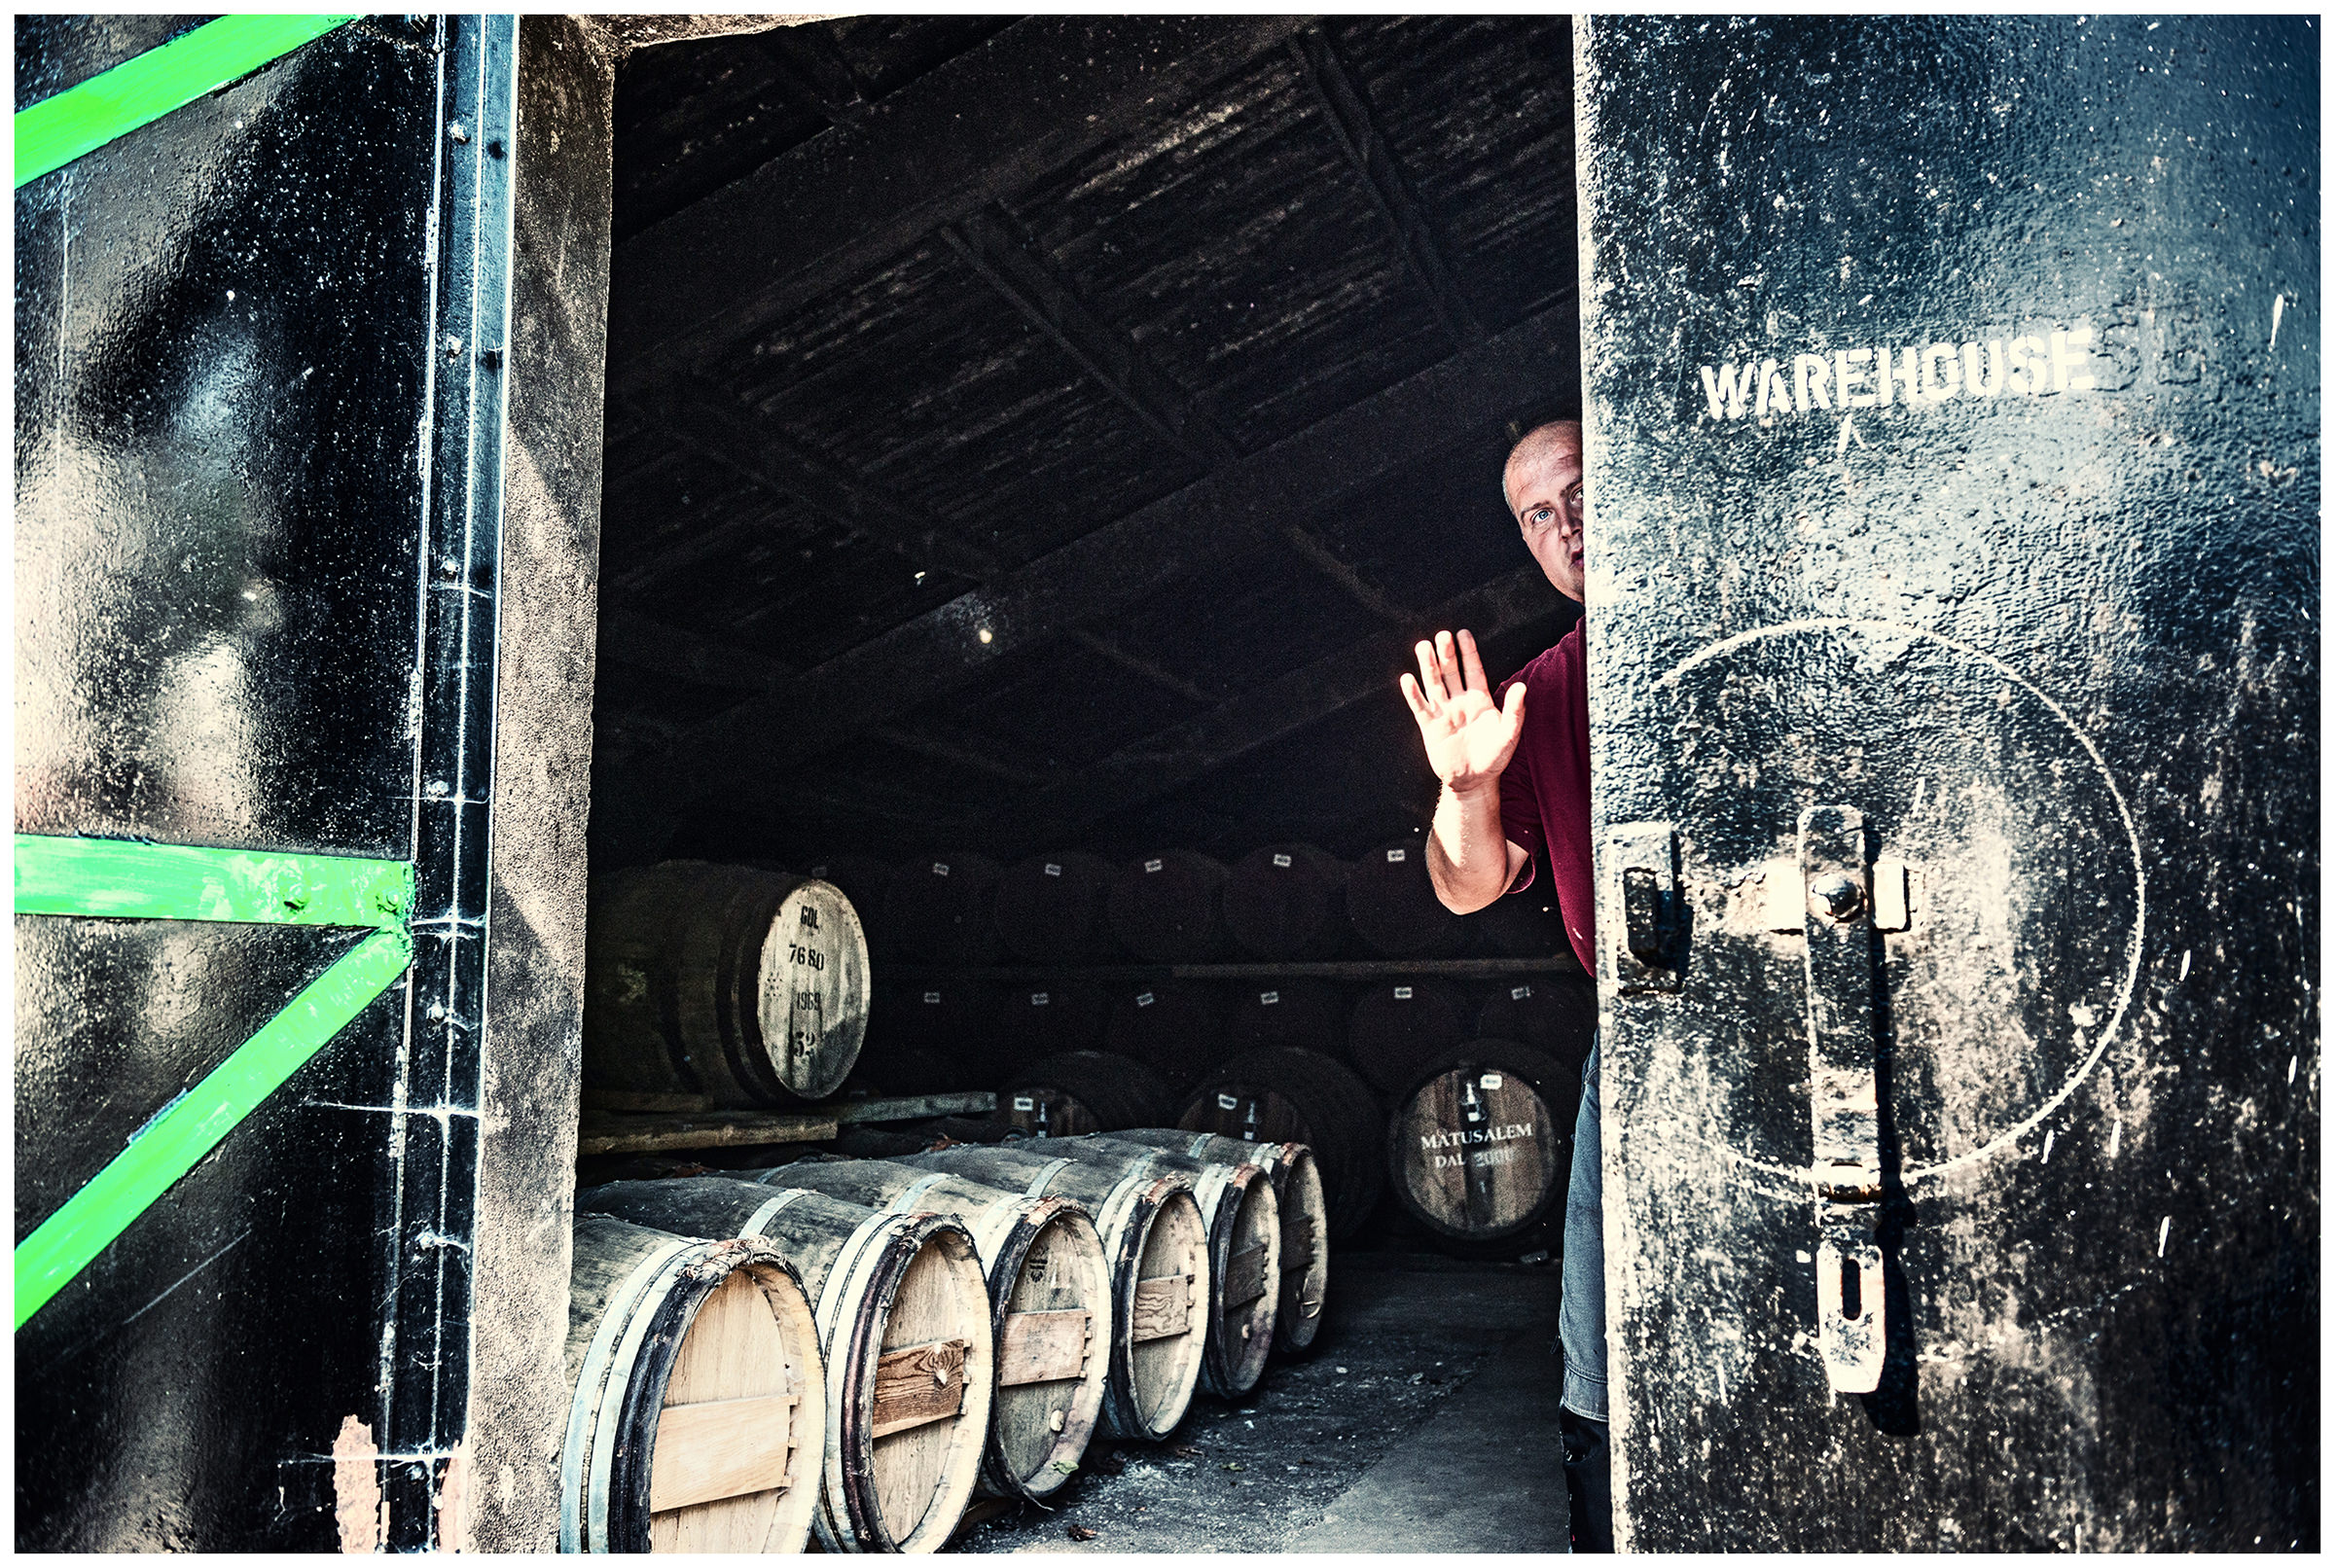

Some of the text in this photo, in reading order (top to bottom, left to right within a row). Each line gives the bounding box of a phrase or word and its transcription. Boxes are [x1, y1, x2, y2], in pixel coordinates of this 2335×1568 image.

[1700, 327, 2096, 420] WAREHOUSE
[796, 992, 821, 1011] 1969
[1420, 1123, 1533, 1150] MATUSALEM
